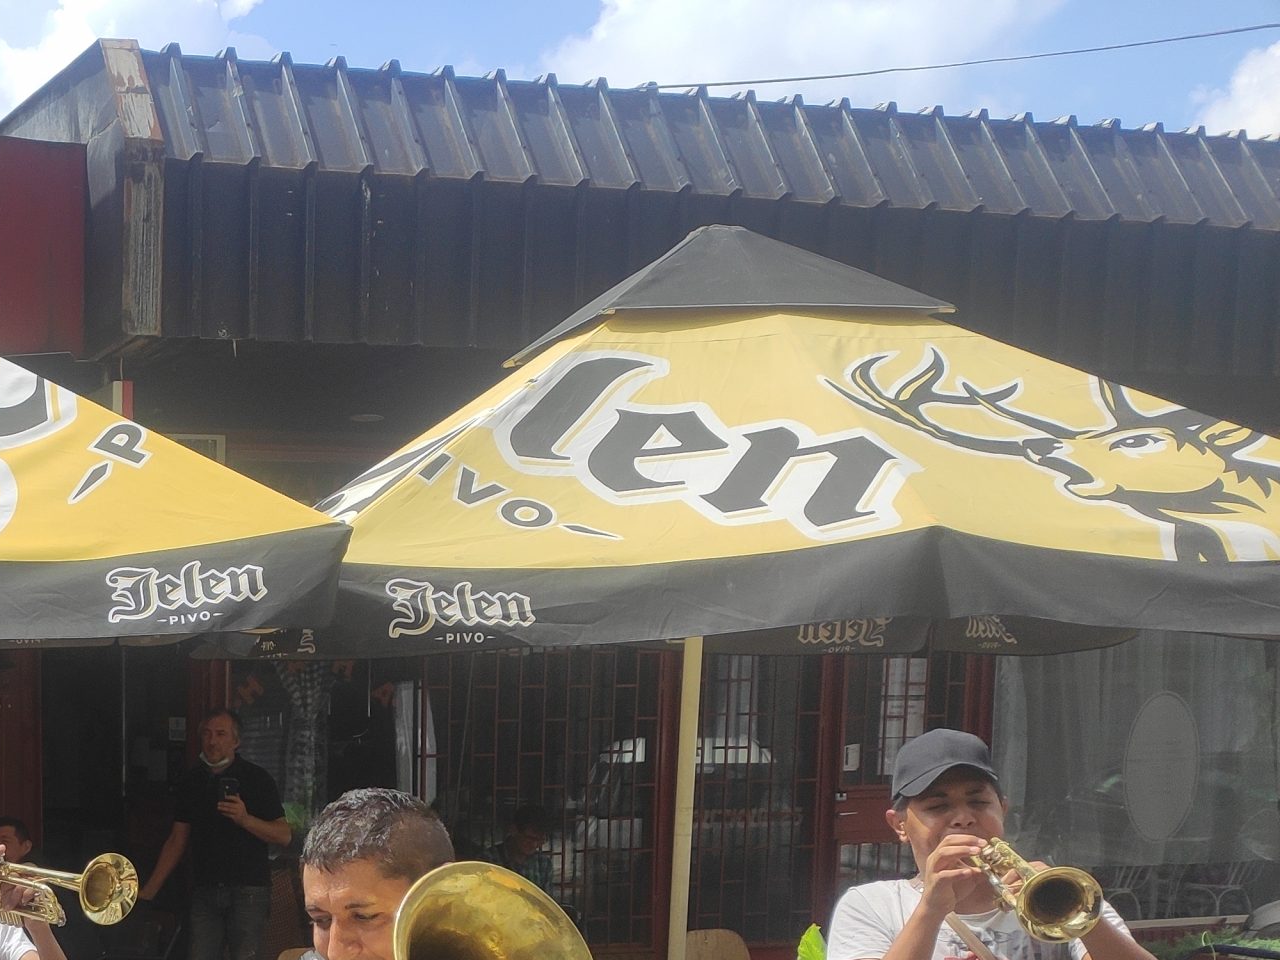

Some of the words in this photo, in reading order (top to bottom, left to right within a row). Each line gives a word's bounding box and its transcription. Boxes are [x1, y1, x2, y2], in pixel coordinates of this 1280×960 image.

[105, 560, 268, 623] Jelen
[385, 578, 536, 638] Jelen
[169, 611, 211, 625] PIVO
[445, 632, 485, 644] PIVO
